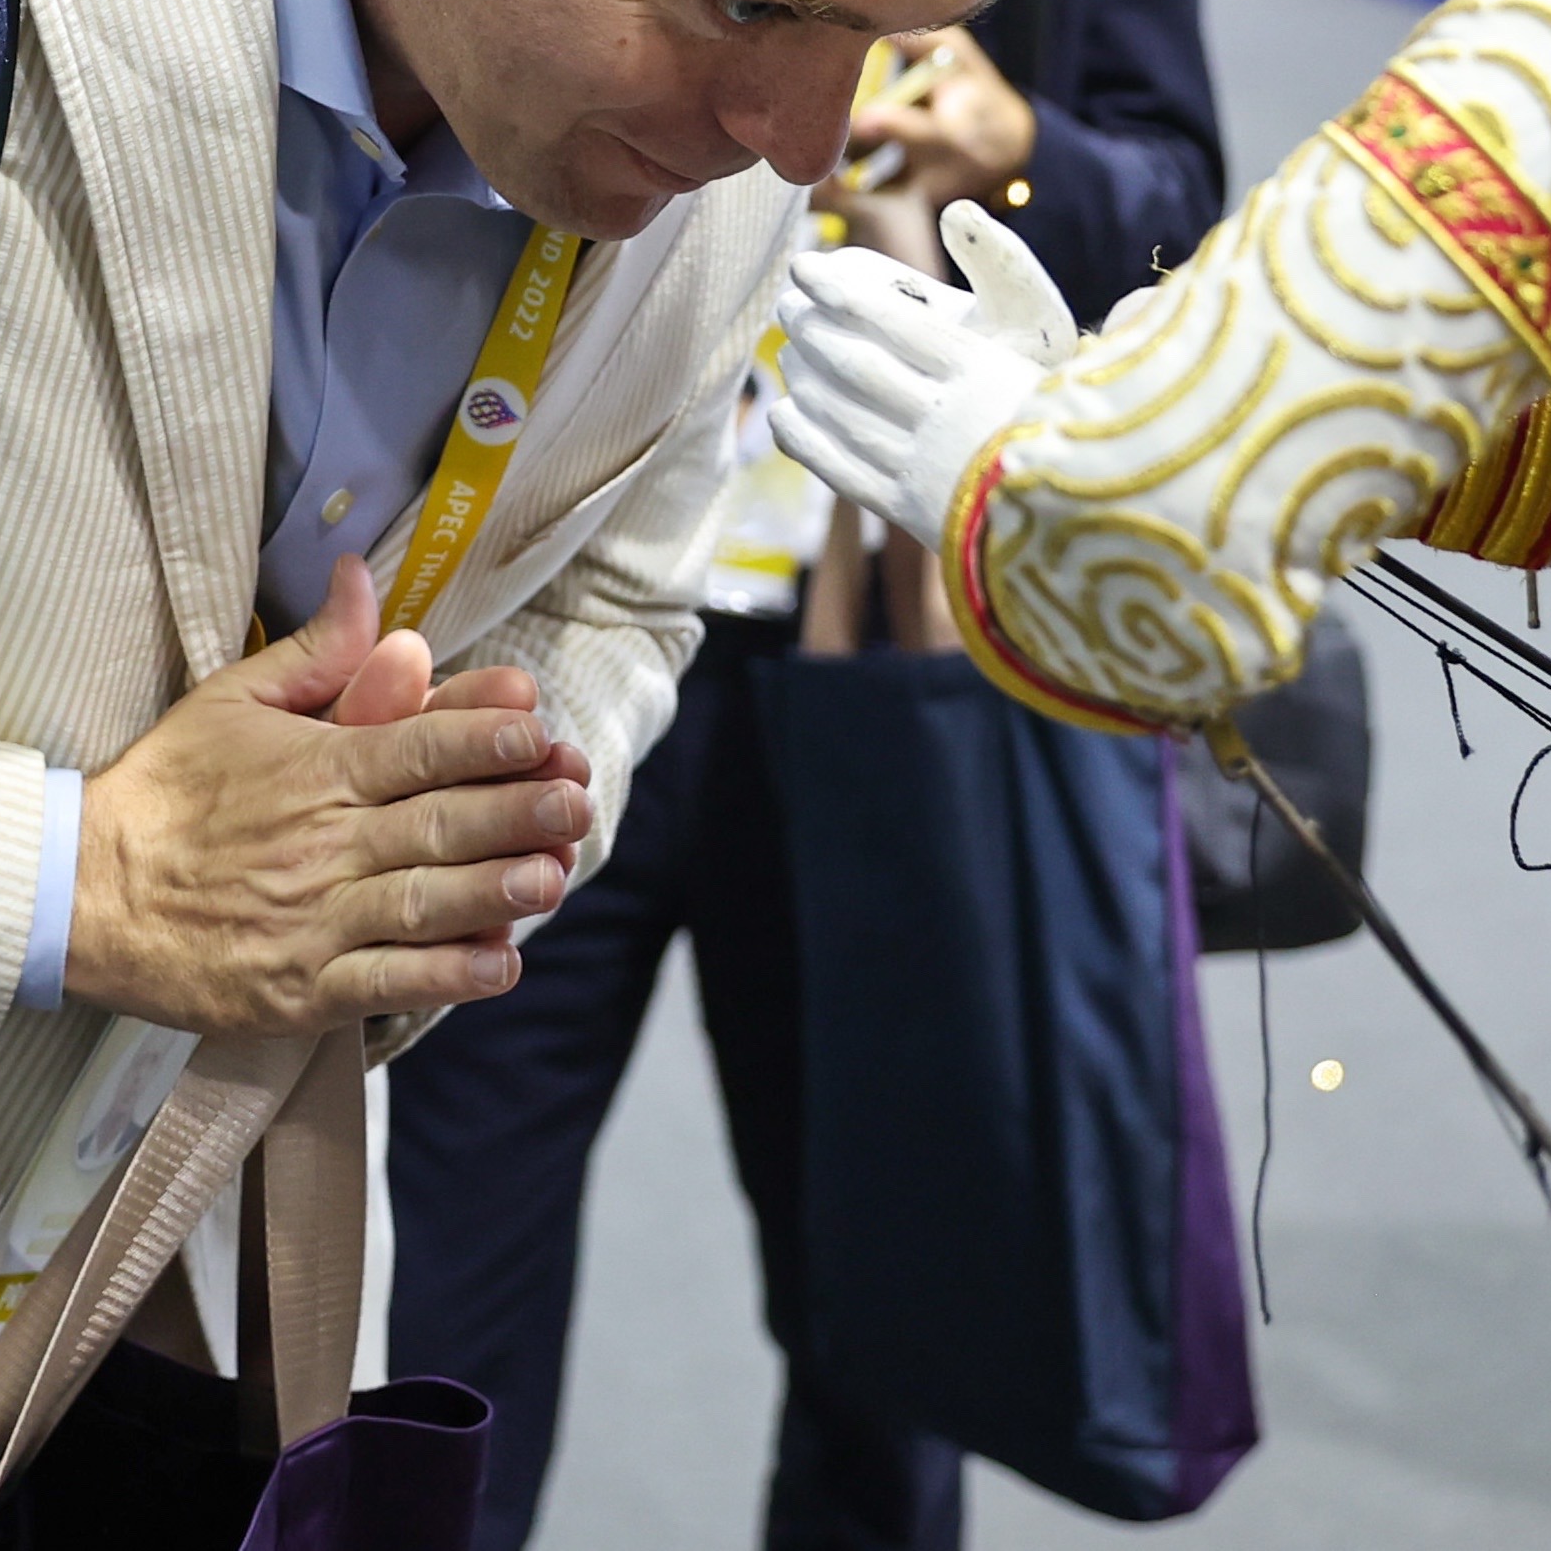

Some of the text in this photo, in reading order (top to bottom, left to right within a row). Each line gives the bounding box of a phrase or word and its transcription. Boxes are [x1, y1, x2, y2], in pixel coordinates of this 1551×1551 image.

[509, 268, 552, 342] 2022
[387, 479, 477, 631] APEC THAILA
